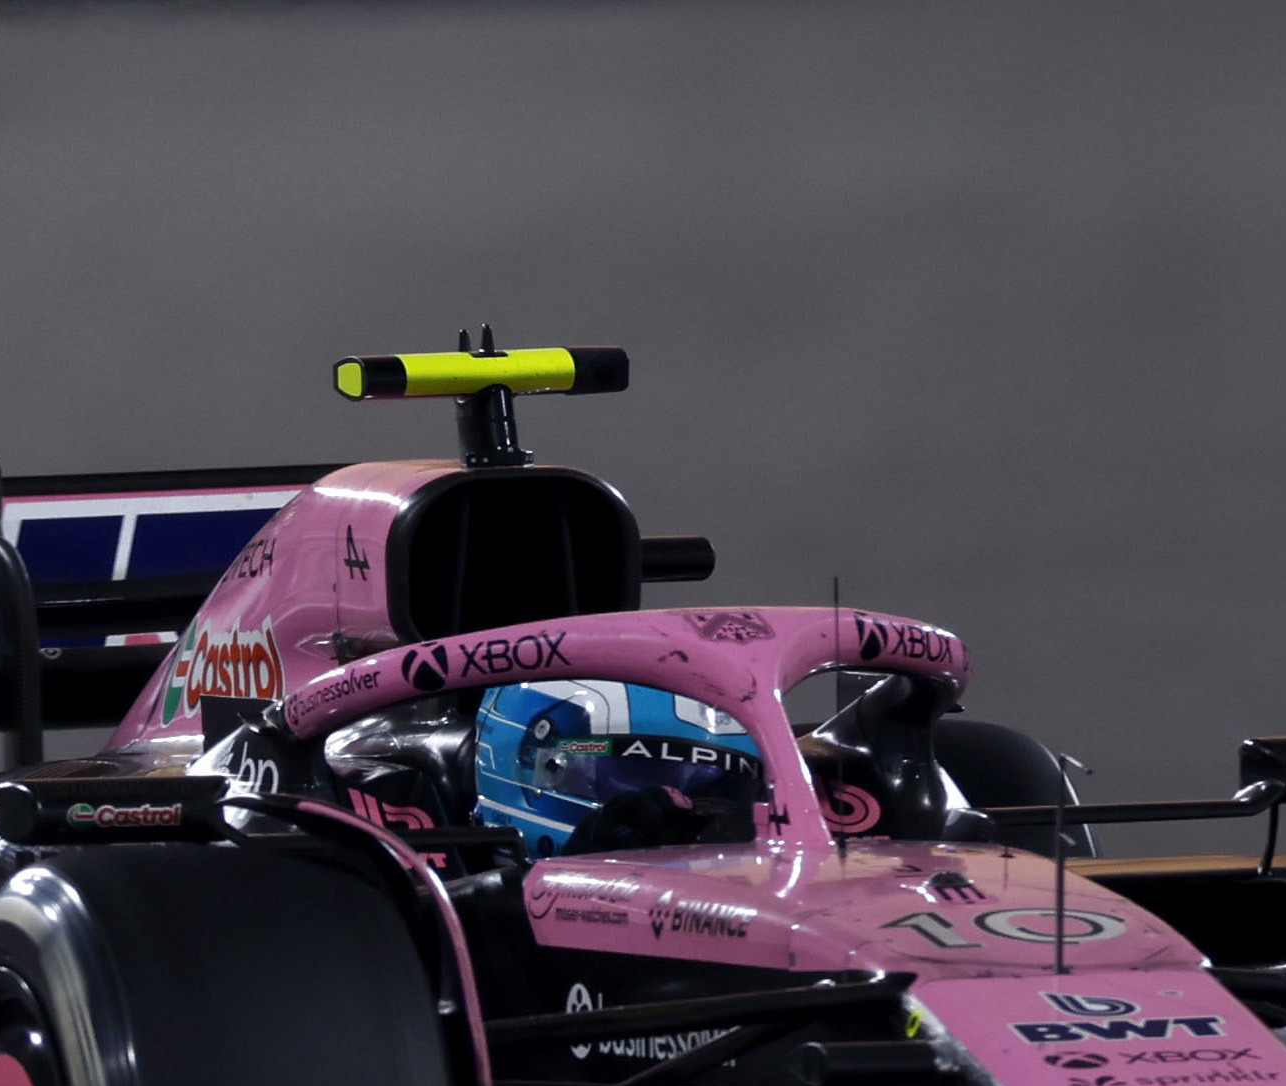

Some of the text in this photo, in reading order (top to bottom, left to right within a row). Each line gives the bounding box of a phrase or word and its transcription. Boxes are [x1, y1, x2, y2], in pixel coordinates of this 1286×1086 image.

[460, 632, 571, 677] XBOX
[889, 621, 953, 664] XBOX
[186, 620, 285, 712] Castrol
[620, 739, 759, 779] ALPIN
[96, 803, 182, 828] Castrol
[879, 907, 1128, 948] 10
[1010, 1016, 1223, 1044] BWT
[1119, 1048, 1261, 1064] XBOX
